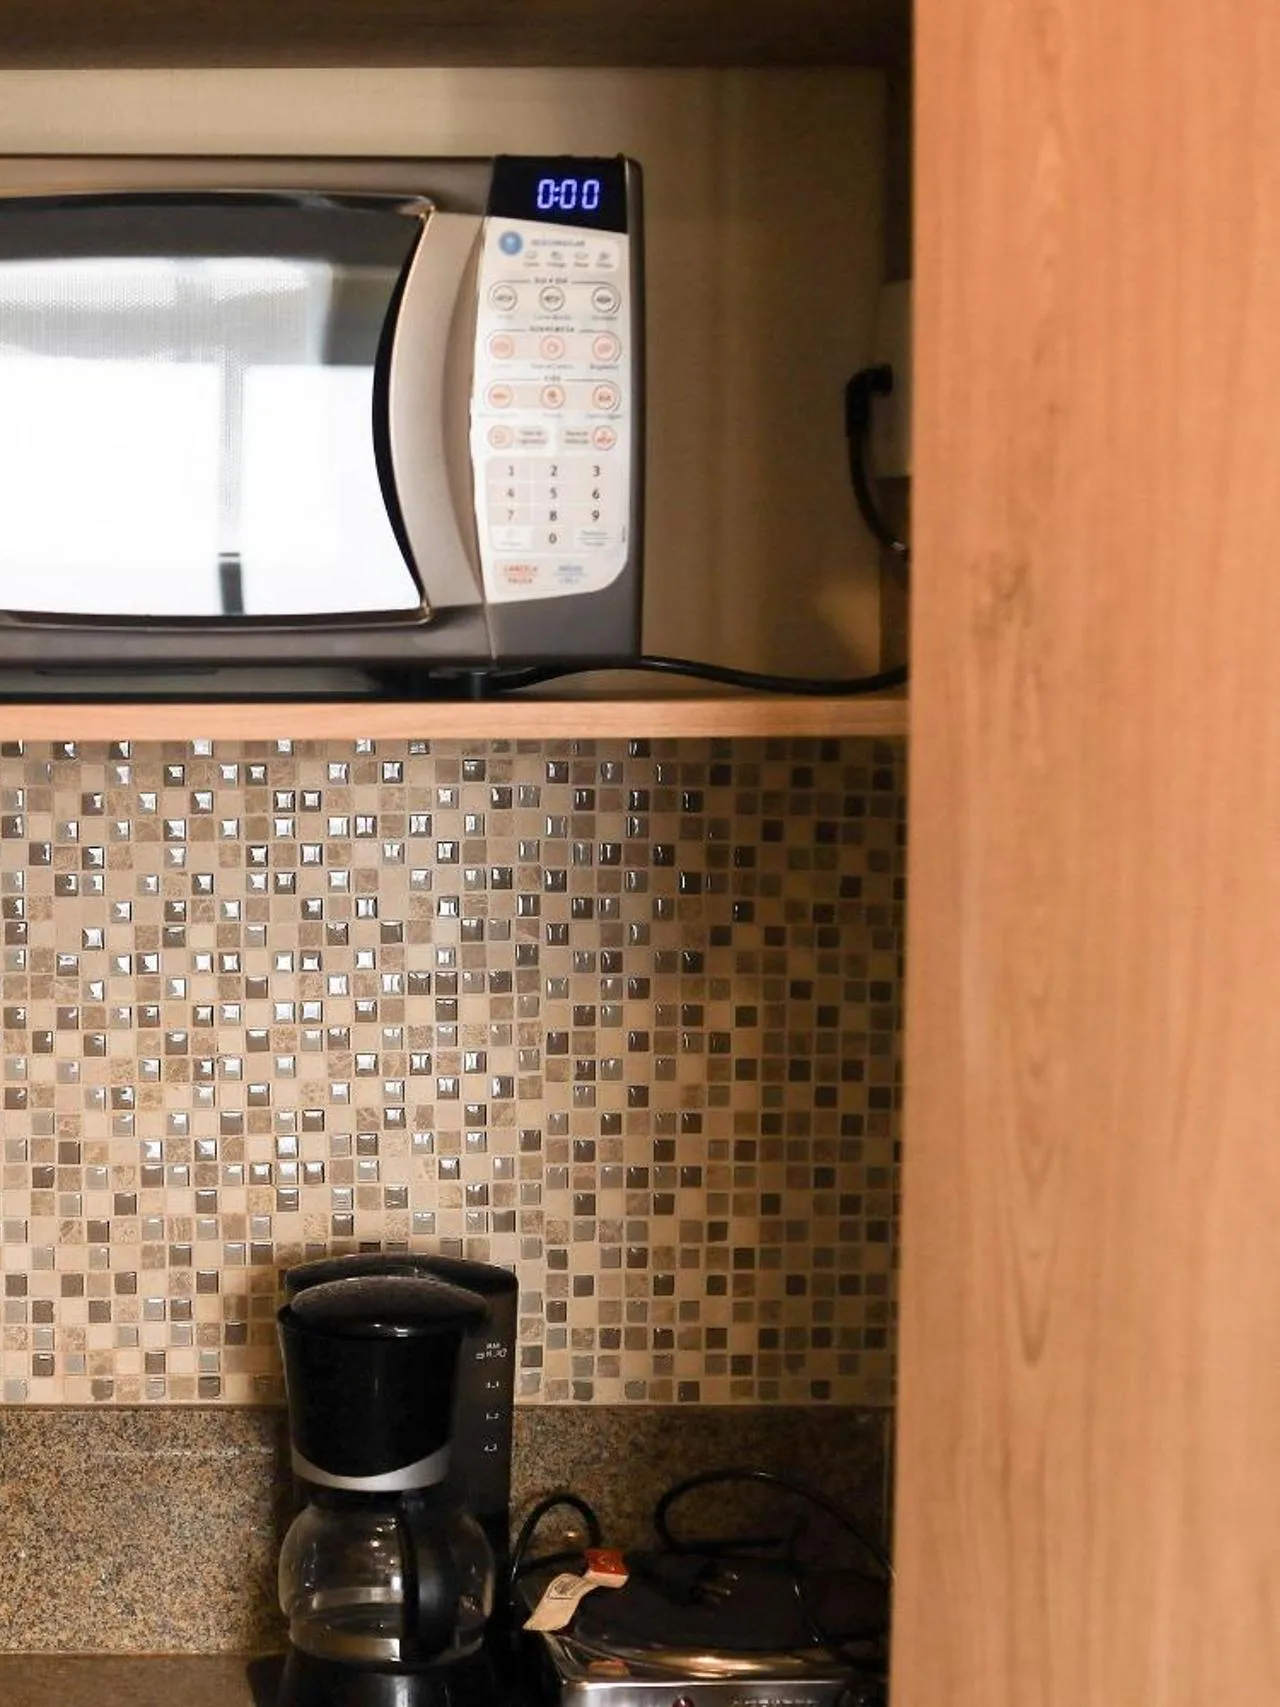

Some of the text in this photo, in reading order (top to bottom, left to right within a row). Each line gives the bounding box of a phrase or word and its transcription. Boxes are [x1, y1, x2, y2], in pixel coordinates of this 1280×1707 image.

[537, 179, 600, 209] 0:00
[507, 465, 515, 477] 1
[550, 464, 558, 477] 2
[592, 464, 601, 477] 3
[549, 487, 558, 500] 5
[592, 487, 600, 500] 6
[507, 509, 515, 521] 7
[549, 510, 558, 522] 8
[591, 510, 600, 522] 9
[548, 532, 558, 545] 0
